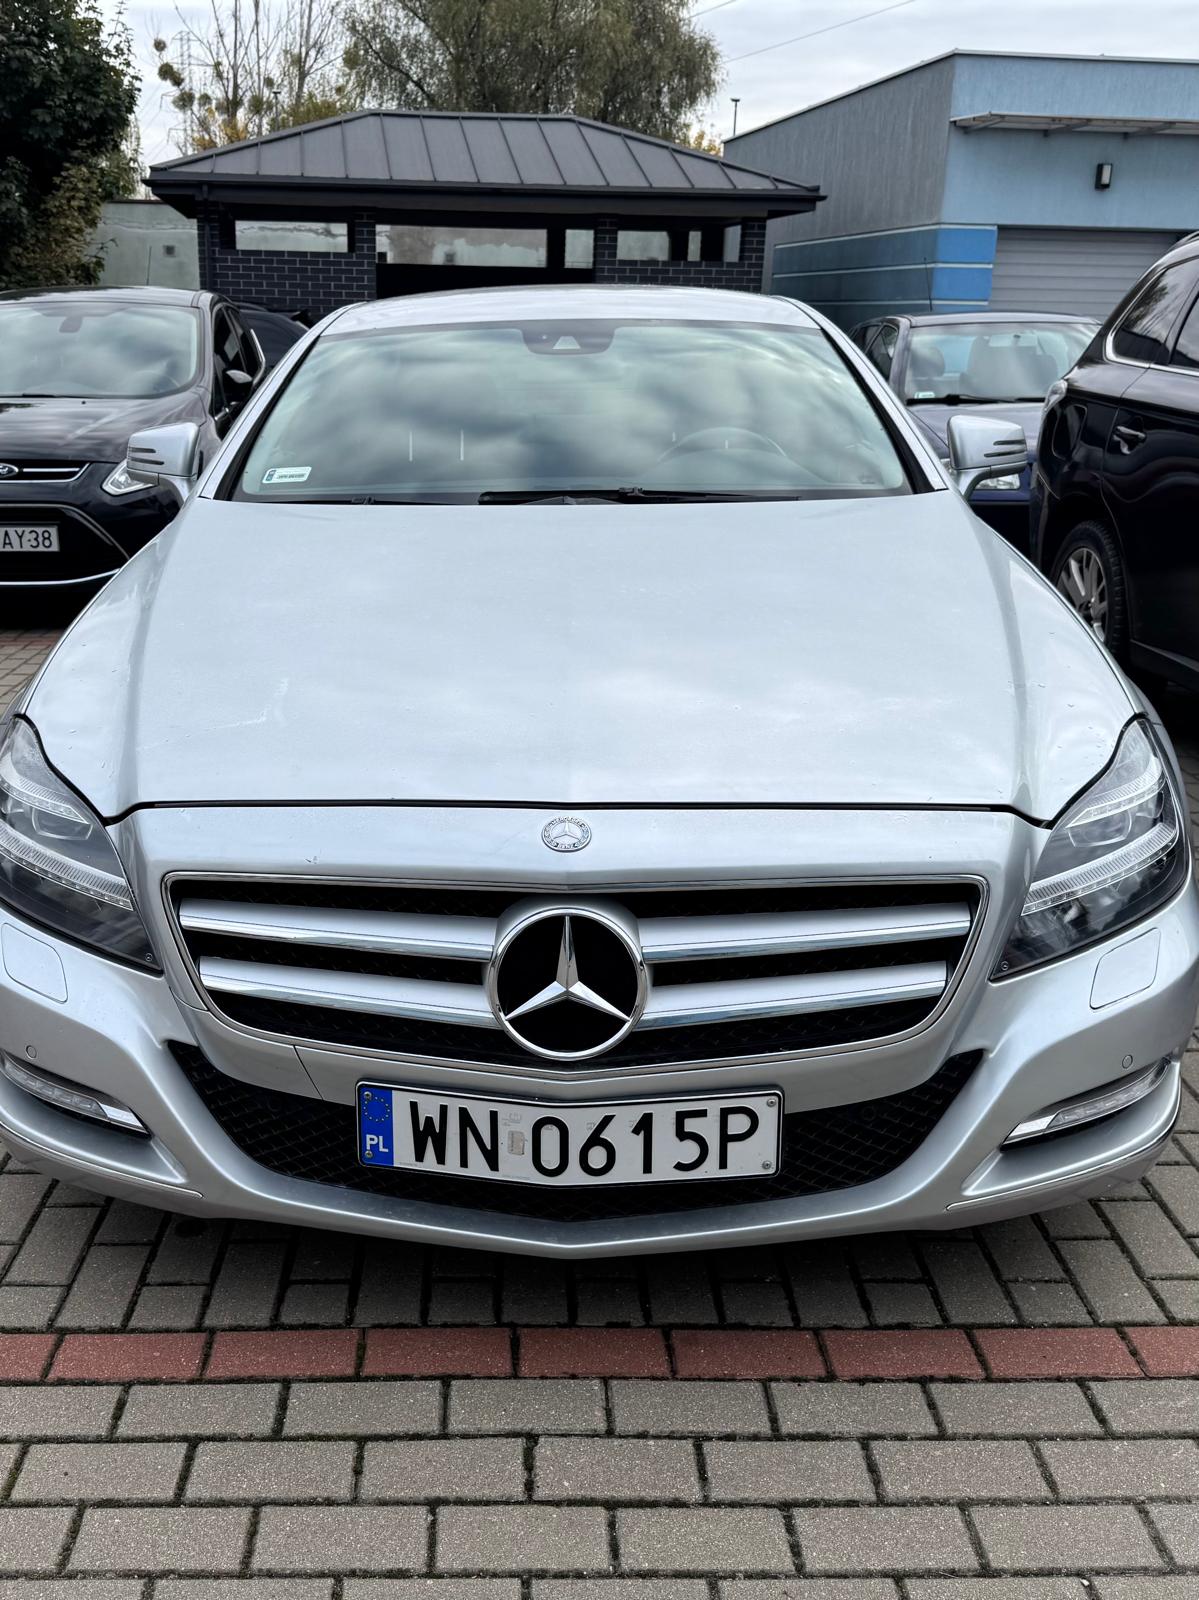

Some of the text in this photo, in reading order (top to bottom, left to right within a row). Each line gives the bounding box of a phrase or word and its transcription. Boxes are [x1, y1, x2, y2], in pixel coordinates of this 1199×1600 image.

[365, 1133, 389, 1153] PL
[409, 1100, 760, 1178] WN 0615P
